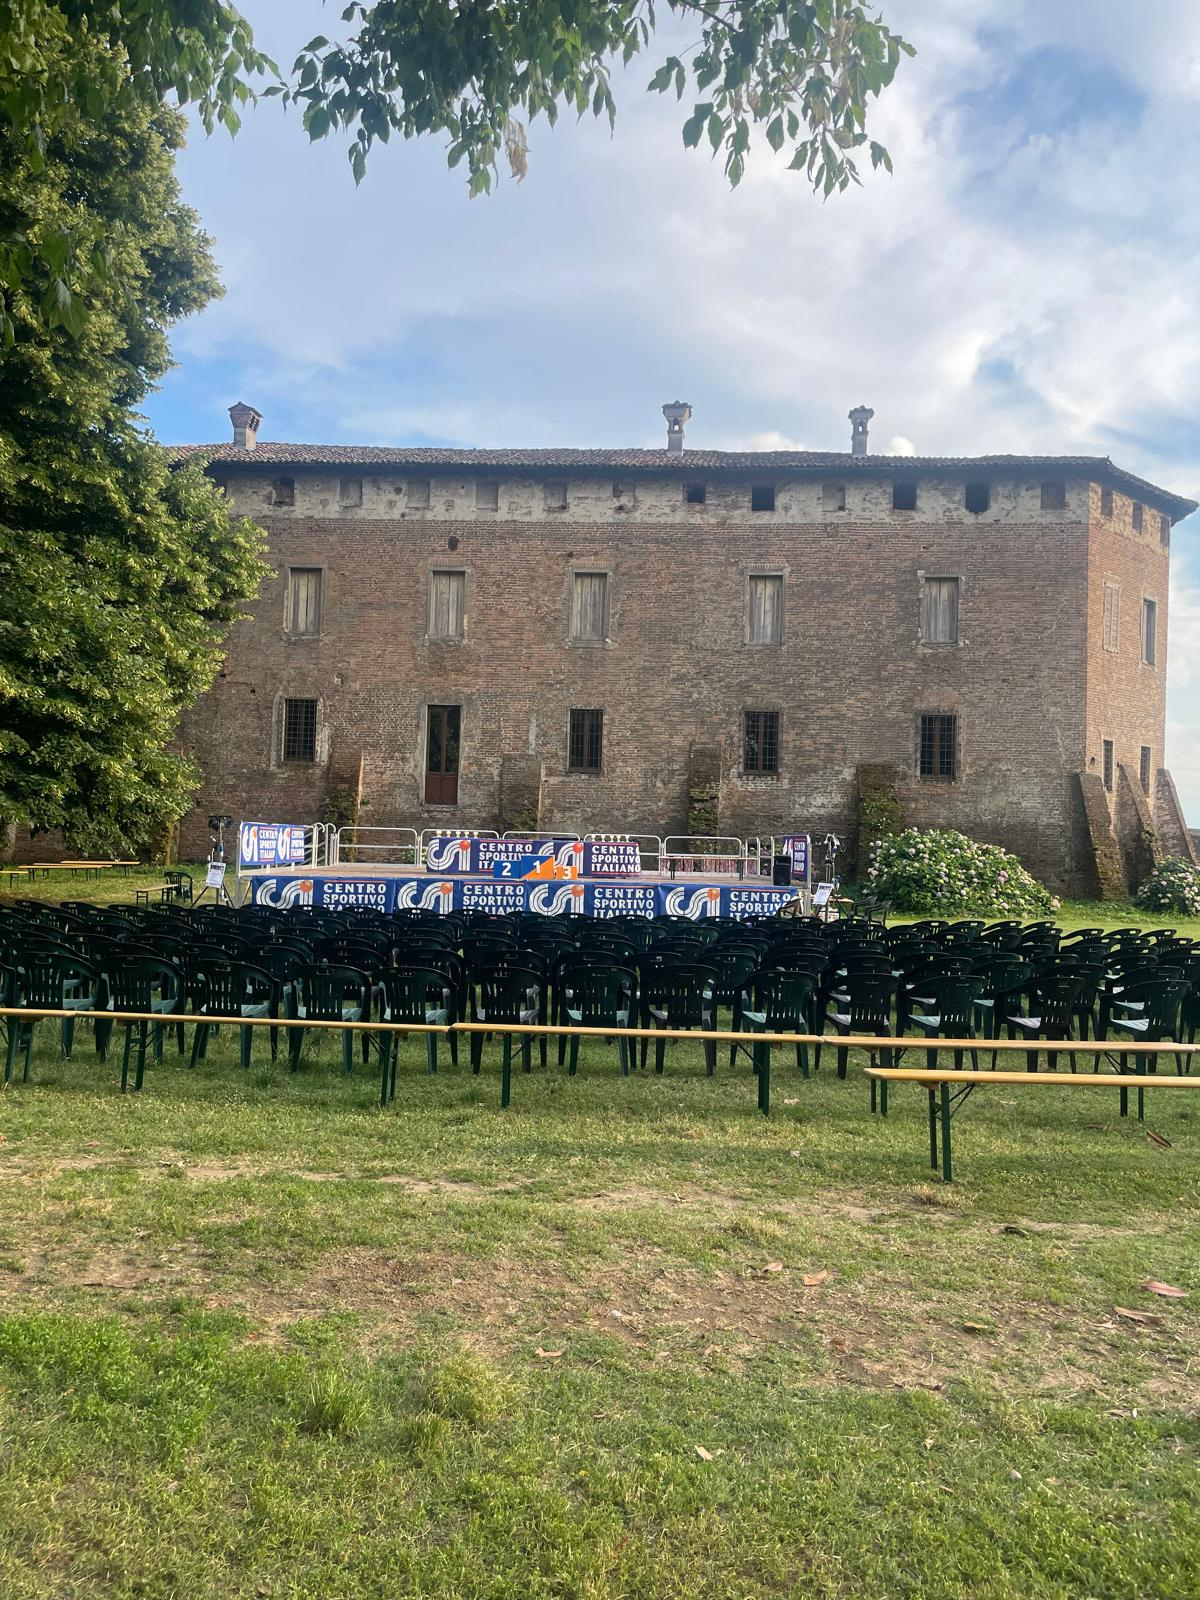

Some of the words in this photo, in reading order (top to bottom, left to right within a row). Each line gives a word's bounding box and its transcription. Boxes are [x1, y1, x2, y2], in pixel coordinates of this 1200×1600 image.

[479, 842, 532, 852] CENTRO
[479, 852, 531, 861] SPORTI
[592, 855, 640, 864] SPORTIVO
[501, 862, 512, 876] 2
[533, 860, 540, 874] 1
[592, 864, 640, 873] ITALIANO
[562, 867, 572, 879] 3
[323, 883, 386, 893] CENTRO
[463, 885, 524, 895] CENTRO
[594, 888, 655, 899] CENTRO
[730, 891, 791, 902] CENTRO
[323, 894, 386, 904] SPORTIVO
[463, 896, 524, 906] SPORTIVO
[594, 899, 655, 909] SPORTIVO
